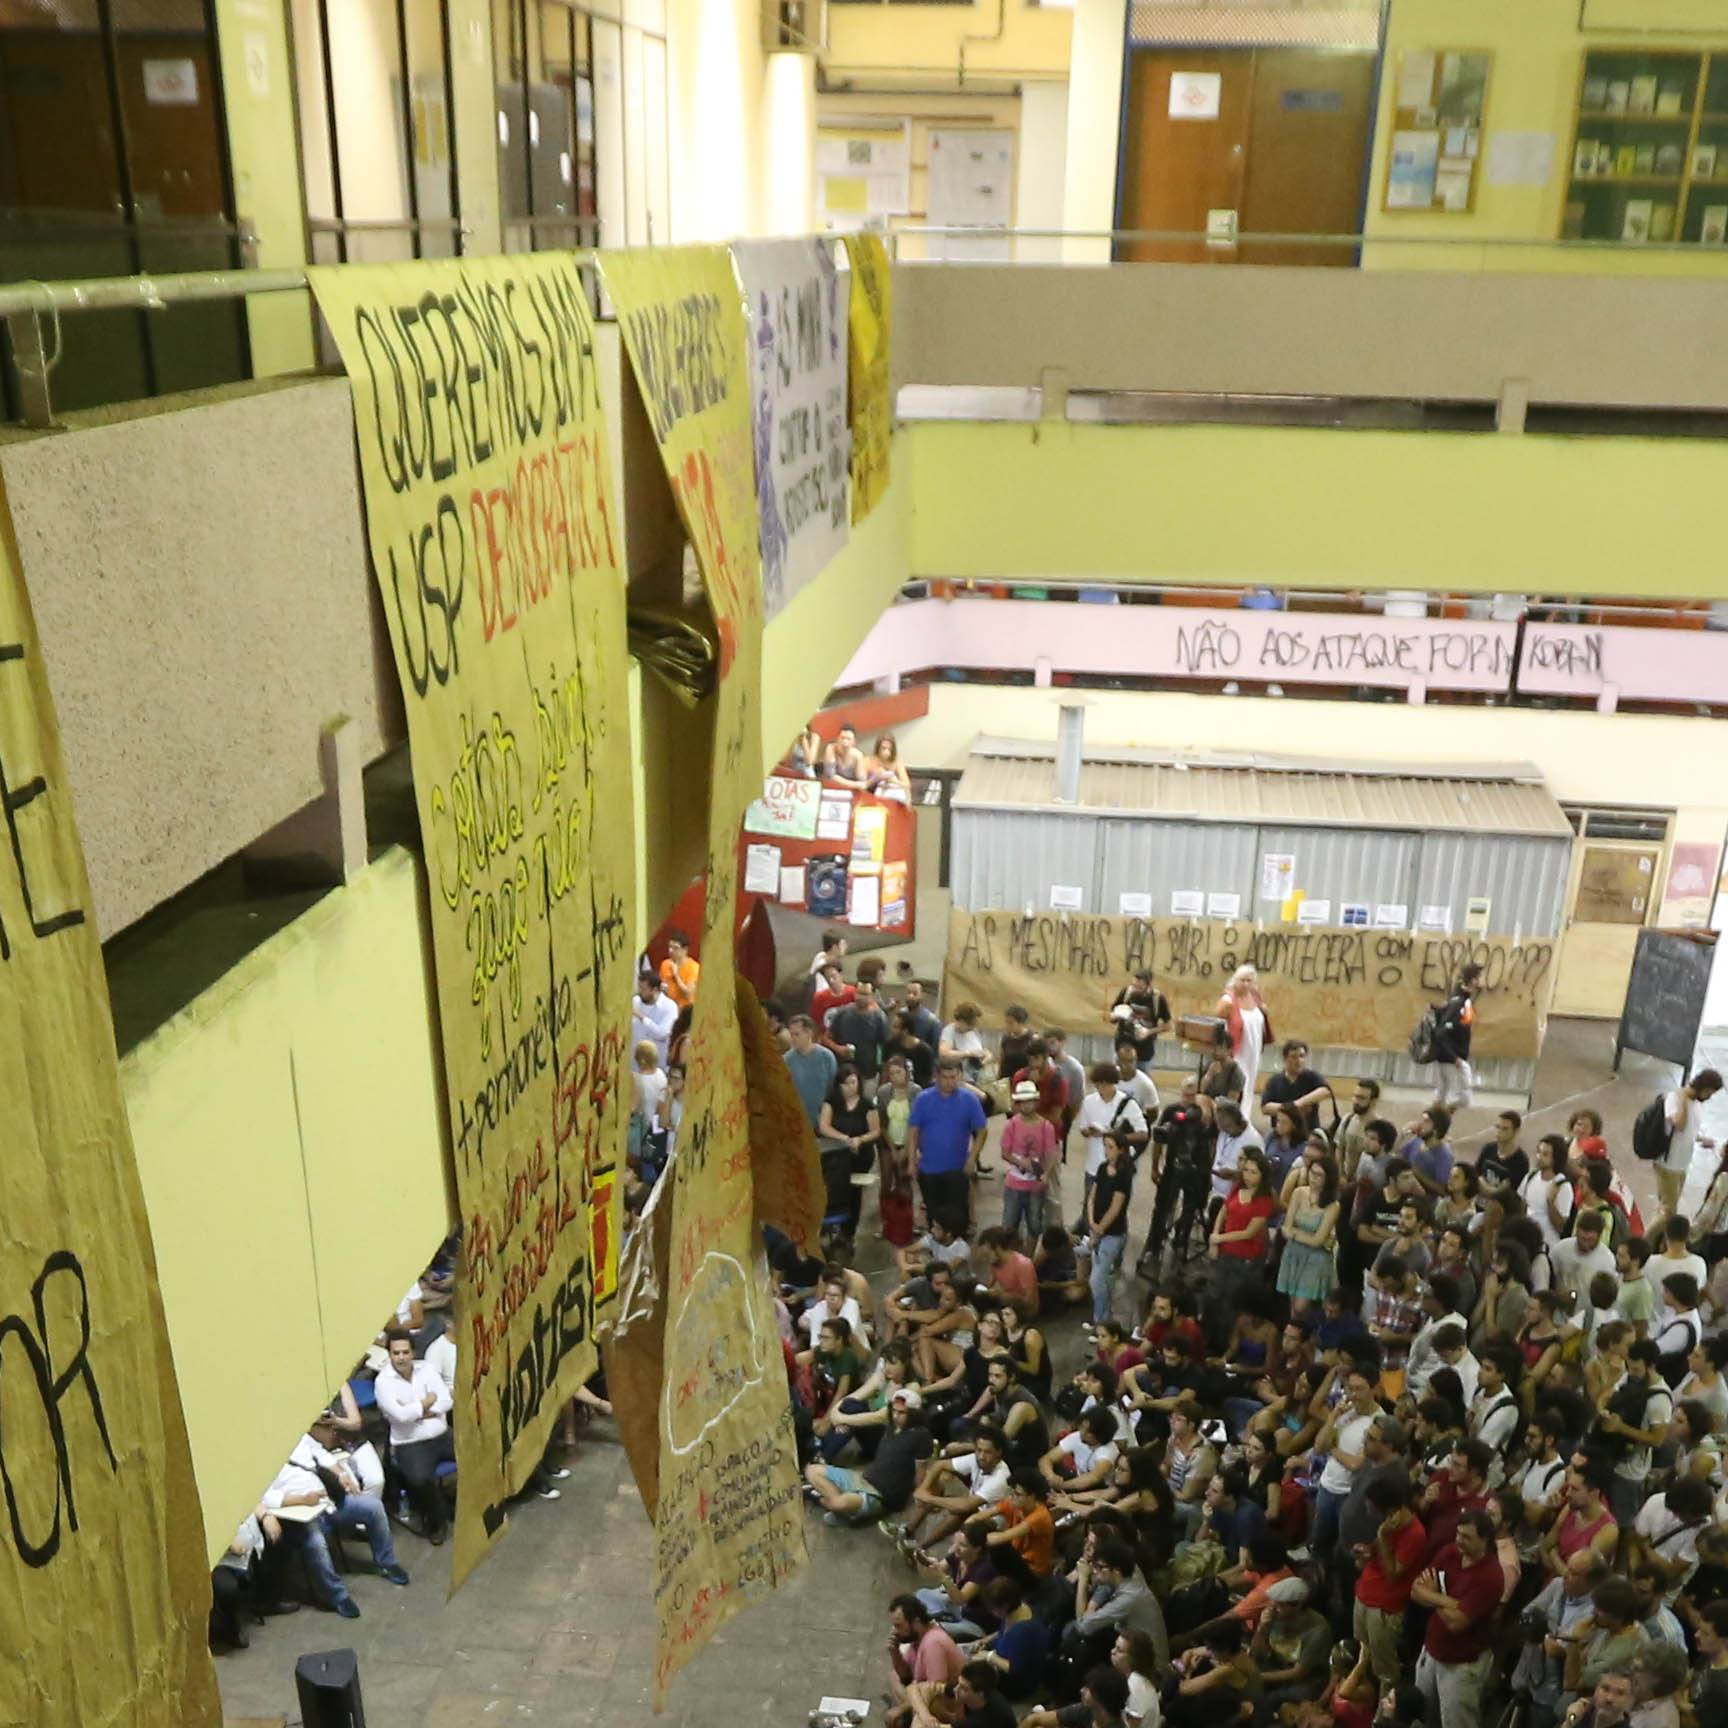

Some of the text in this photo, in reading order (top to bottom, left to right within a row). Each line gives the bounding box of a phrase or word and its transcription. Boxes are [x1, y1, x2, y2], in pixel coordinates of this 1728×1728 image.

[355, 267, 545, 494] QUEREMOS
[527, 266, 600, 427] UMA
[388, 494, 465, 699] USP
[1174, 619, 1241, 672] NÃO
[765, 777, 811, 804] OTAS
[960, 915, 997, 971] AS
[1008, 917, 1111, 976] MESINHAS
